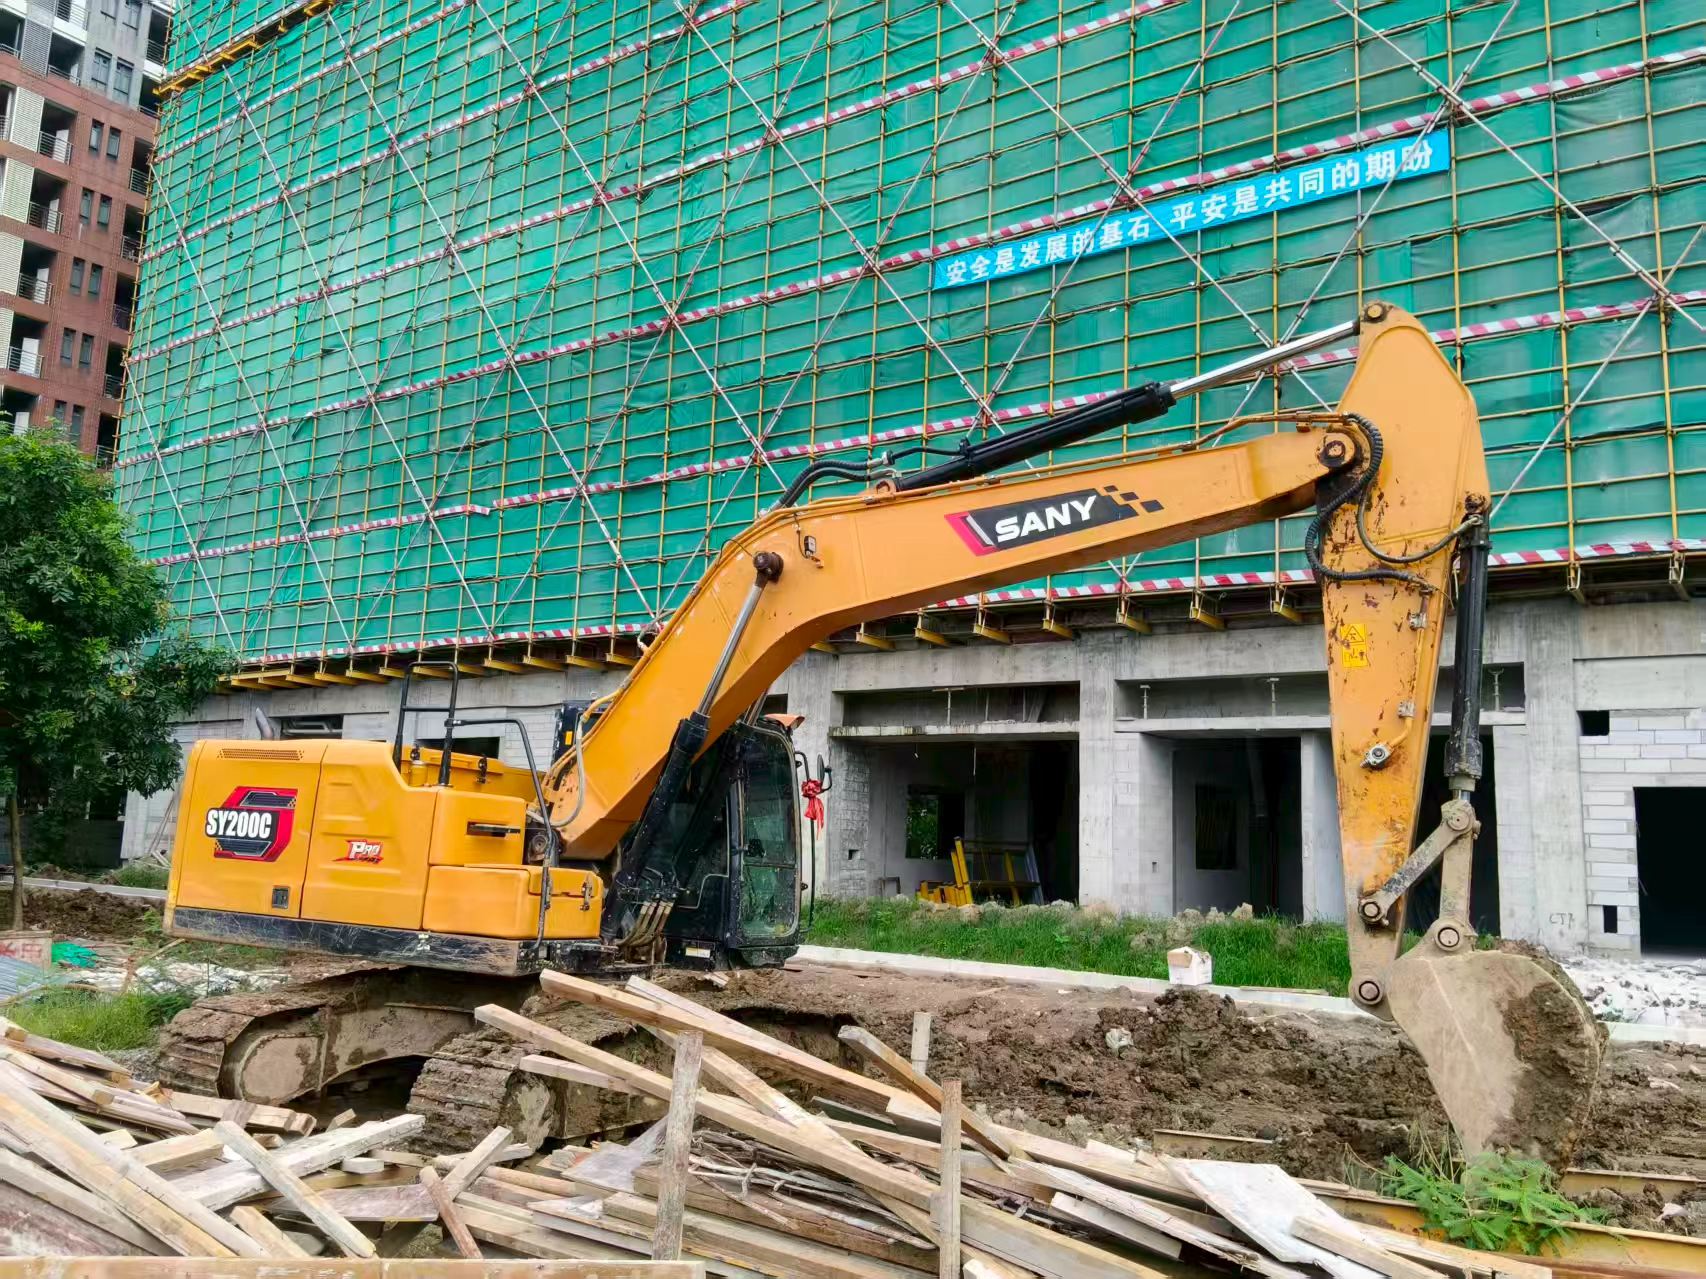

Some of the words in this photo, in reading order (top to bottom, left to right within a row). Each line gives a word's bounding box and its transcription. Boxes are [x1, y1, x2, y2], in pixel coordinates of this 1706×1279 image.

[946, 215, 1150, 285] 安全是发展的基石
[1169, 140, 1432, 230] 平安是共同的期盼
[995, 495, 1097, 543] SANY
[206, 810, 272, 839] SY200C
